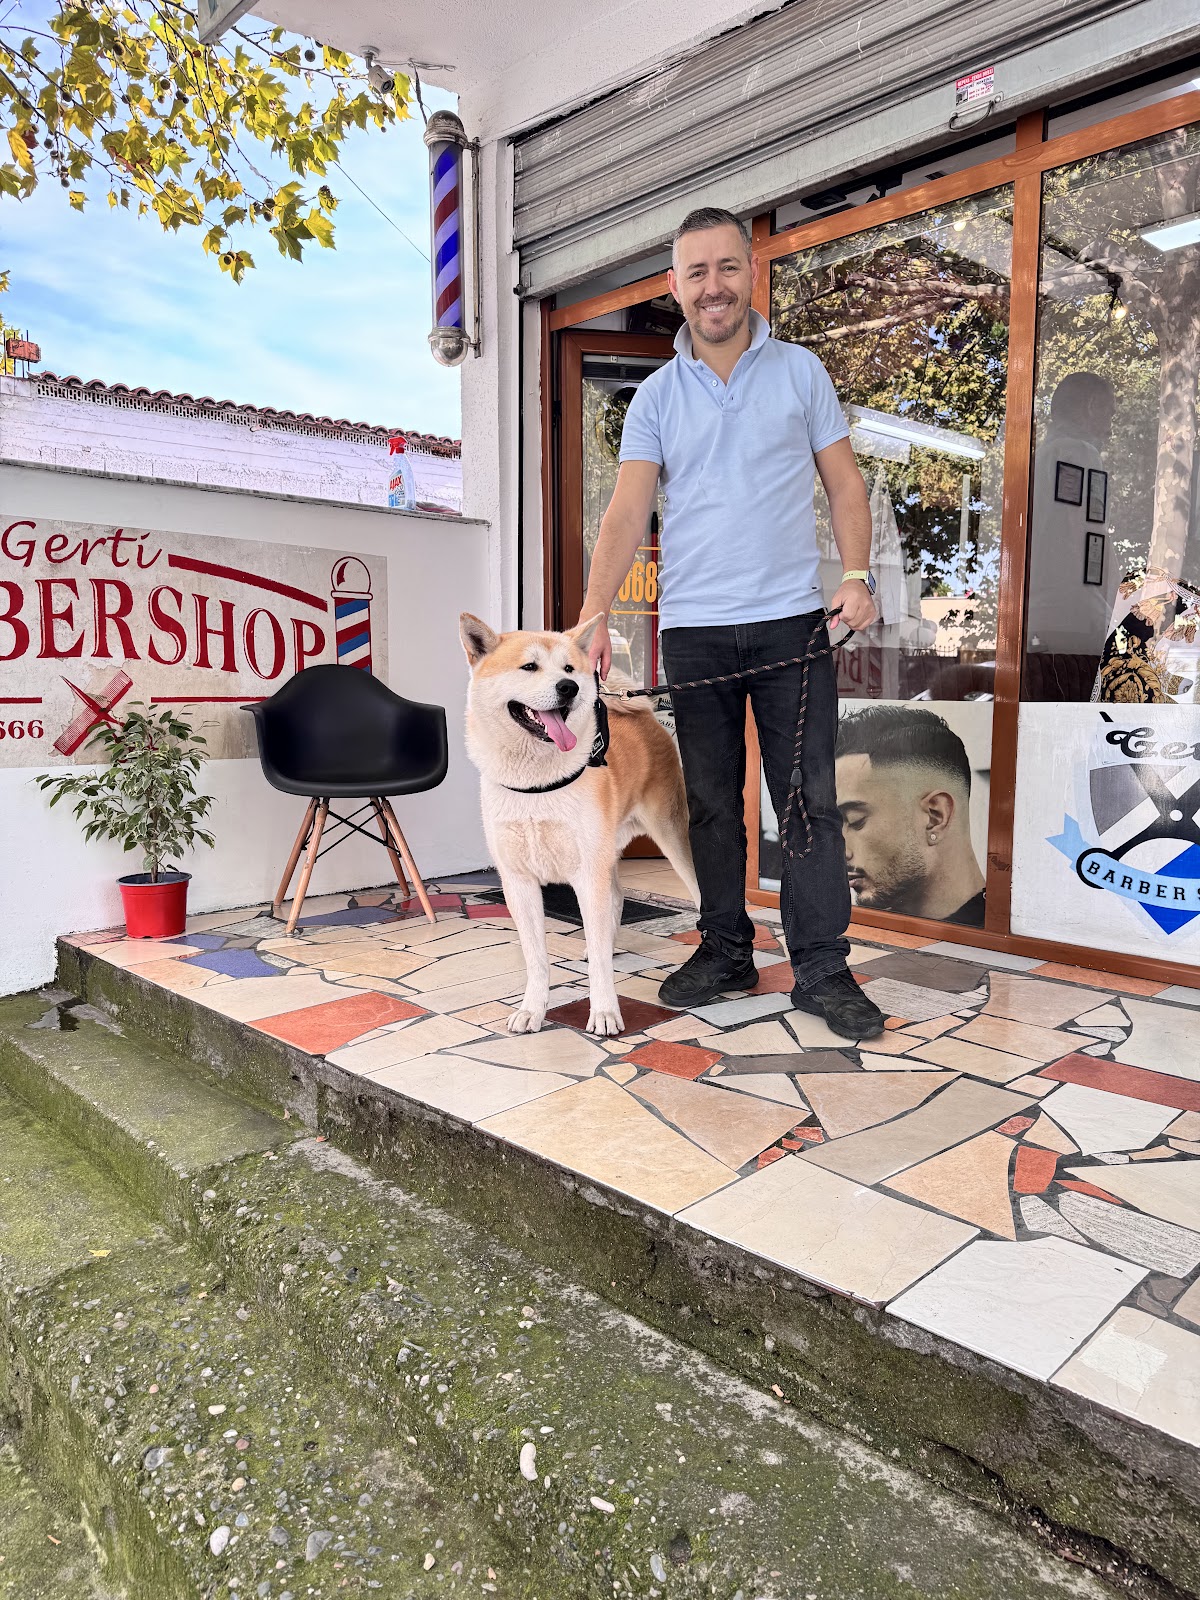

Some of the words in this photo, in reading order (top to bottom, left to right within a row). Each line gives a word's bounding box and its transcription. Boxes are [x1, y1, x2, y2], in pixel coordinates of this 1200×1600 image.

[390, 475, 403, 491] AJAX
[1, 521, 163, 569] Gerti
[1087, 861, 1186, 901] BARBER
